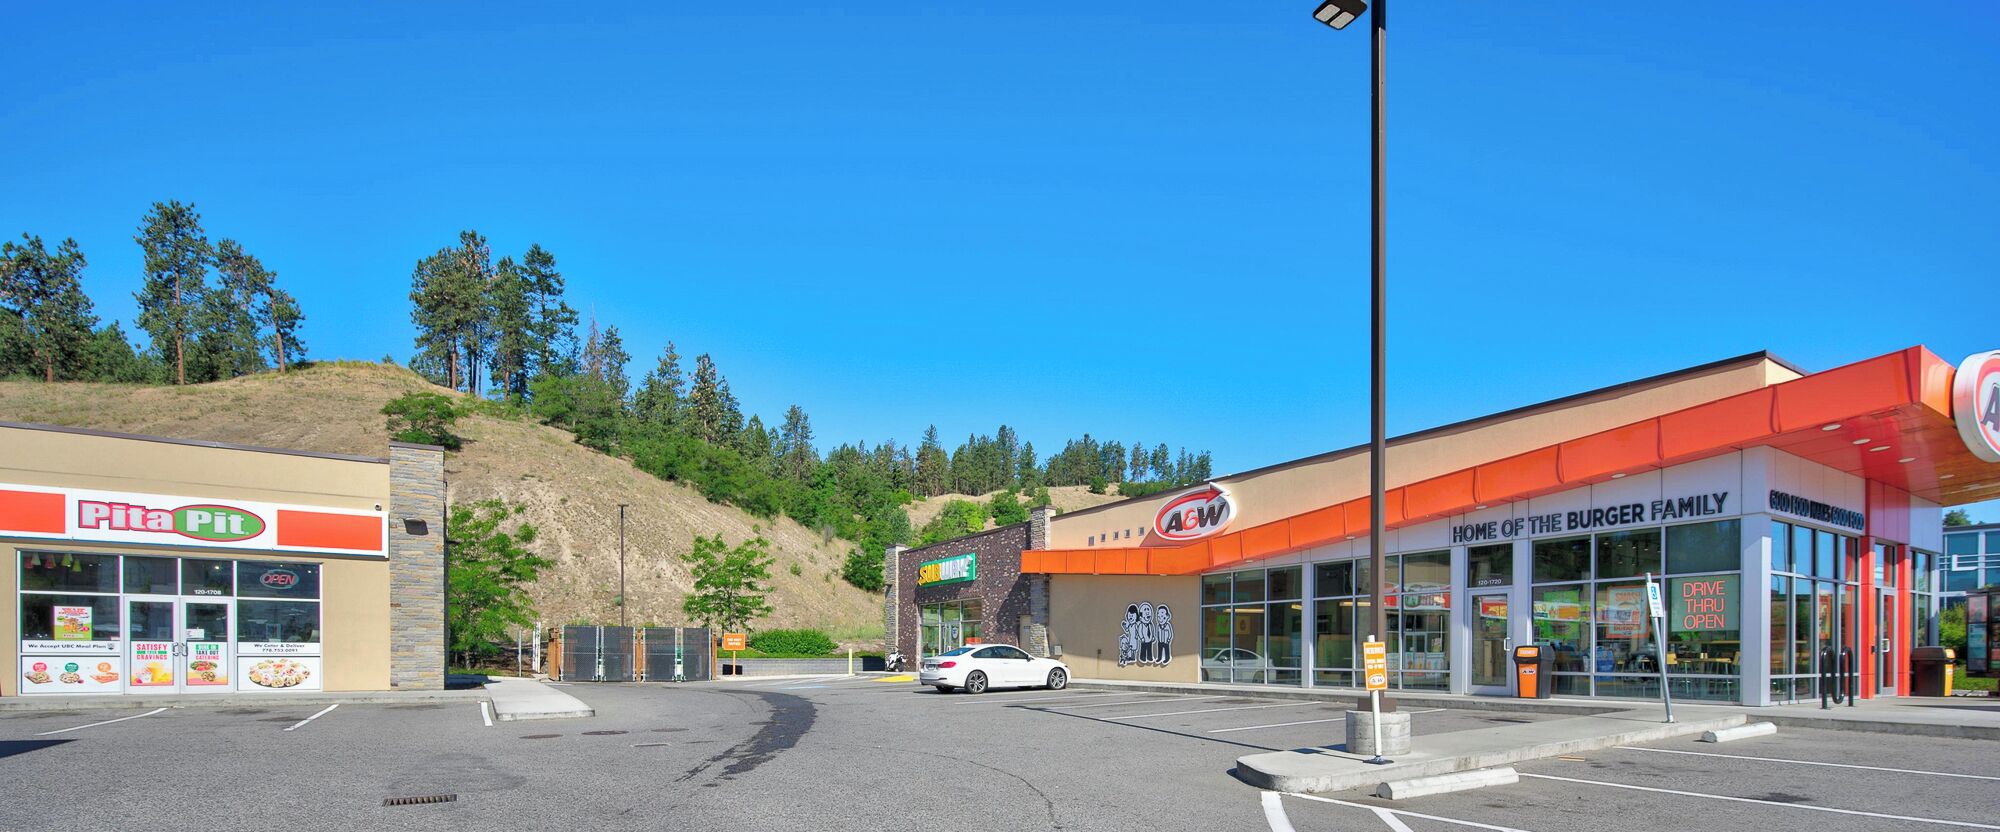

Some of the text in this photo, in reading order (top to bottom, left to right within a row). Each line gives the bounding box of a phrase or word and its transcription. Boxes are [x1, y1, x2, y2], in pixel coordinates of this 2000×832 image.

[79, 500, 249, 535] Pita Pit
[1164, 502, 1227, 533] A&W
[1453, 491, 1728, 543] HOME OF THE BURGER FAMILY
[262, 574, 296, 585] OPEN
[918, 555, 973, 586] SUBWAY
[1683, 580, 1726, 597] DRIVE
[1684, 597, 1725, 613] THRU
[1683, 613, 1725, 630] OPEN
